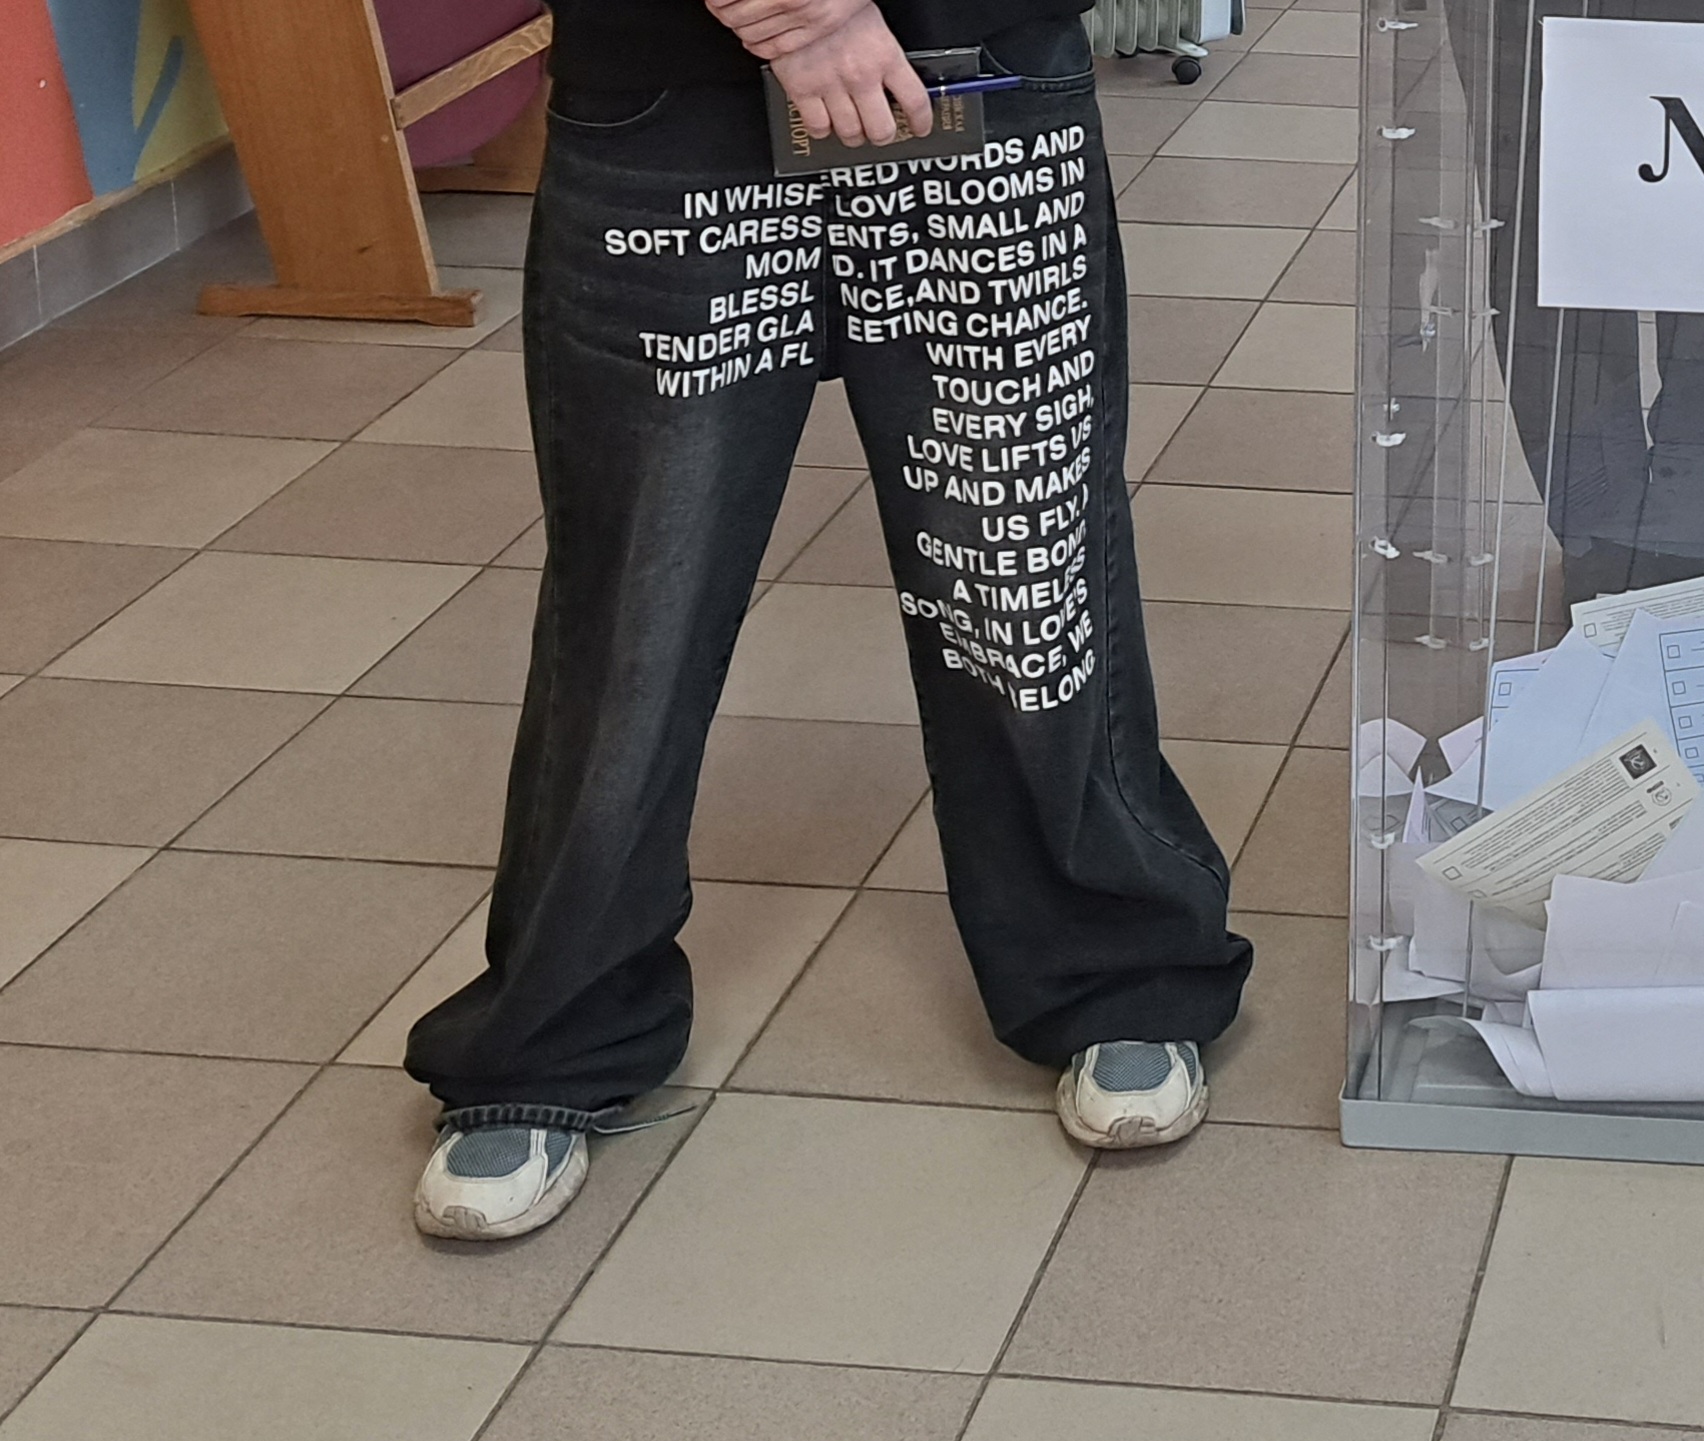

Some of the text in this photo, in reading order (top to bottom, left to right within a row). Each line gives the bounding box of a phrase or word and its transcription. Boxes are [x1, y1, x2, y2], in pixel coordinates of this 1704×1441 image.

[684, 190, 718, 219] IN
[1031, 125, 1085, 160] AND
[604, 156, 1085, 256] SOFT CARESS LOVE BLOOMS IN
[745, 247, 821, 279] MOM
[927, 208, 1029, 240] SMALL
[1034, 191, 1085, 229] AND
[870, 256, 897, 282] IT
[905, 241, 1035, 275] DANCES
[1041, 229, 1067, 260] IN
[1072, 223, 1087, 251] A
[639, 322, 751, 362] TENDER
[757, 310, 814, 342] GLA
[987, 254, 1087, 305] TWIRLS
[656, 287, 1088, 397] WITHIN A FL EETING CHANCE.
[926, 314, 1091, 371] WITH EVERY
[932, 350, 1095, 406] TOUCH AND
[907, 414, 1092, 472] LOVE LIFTS US
[932, 407, 1027, 440] EVERY
[903, 465, 939, 492] UP
[944, 475, 1005, 506] AND
[1015, 446, 1091, 504] MAKES
[982, 515, 1030, 542] US
[1039, 494, 1080, 537] FLY.
[916, 531, 1018, 576] GENTLE
[900, 592, 979, 639] SONG,
[984, 617, 1013, 646] IN
[953, 579, 972, 604] A
[1067, 610, 1093, 653] WE
[942, 648, 1005, 695] BOTH
